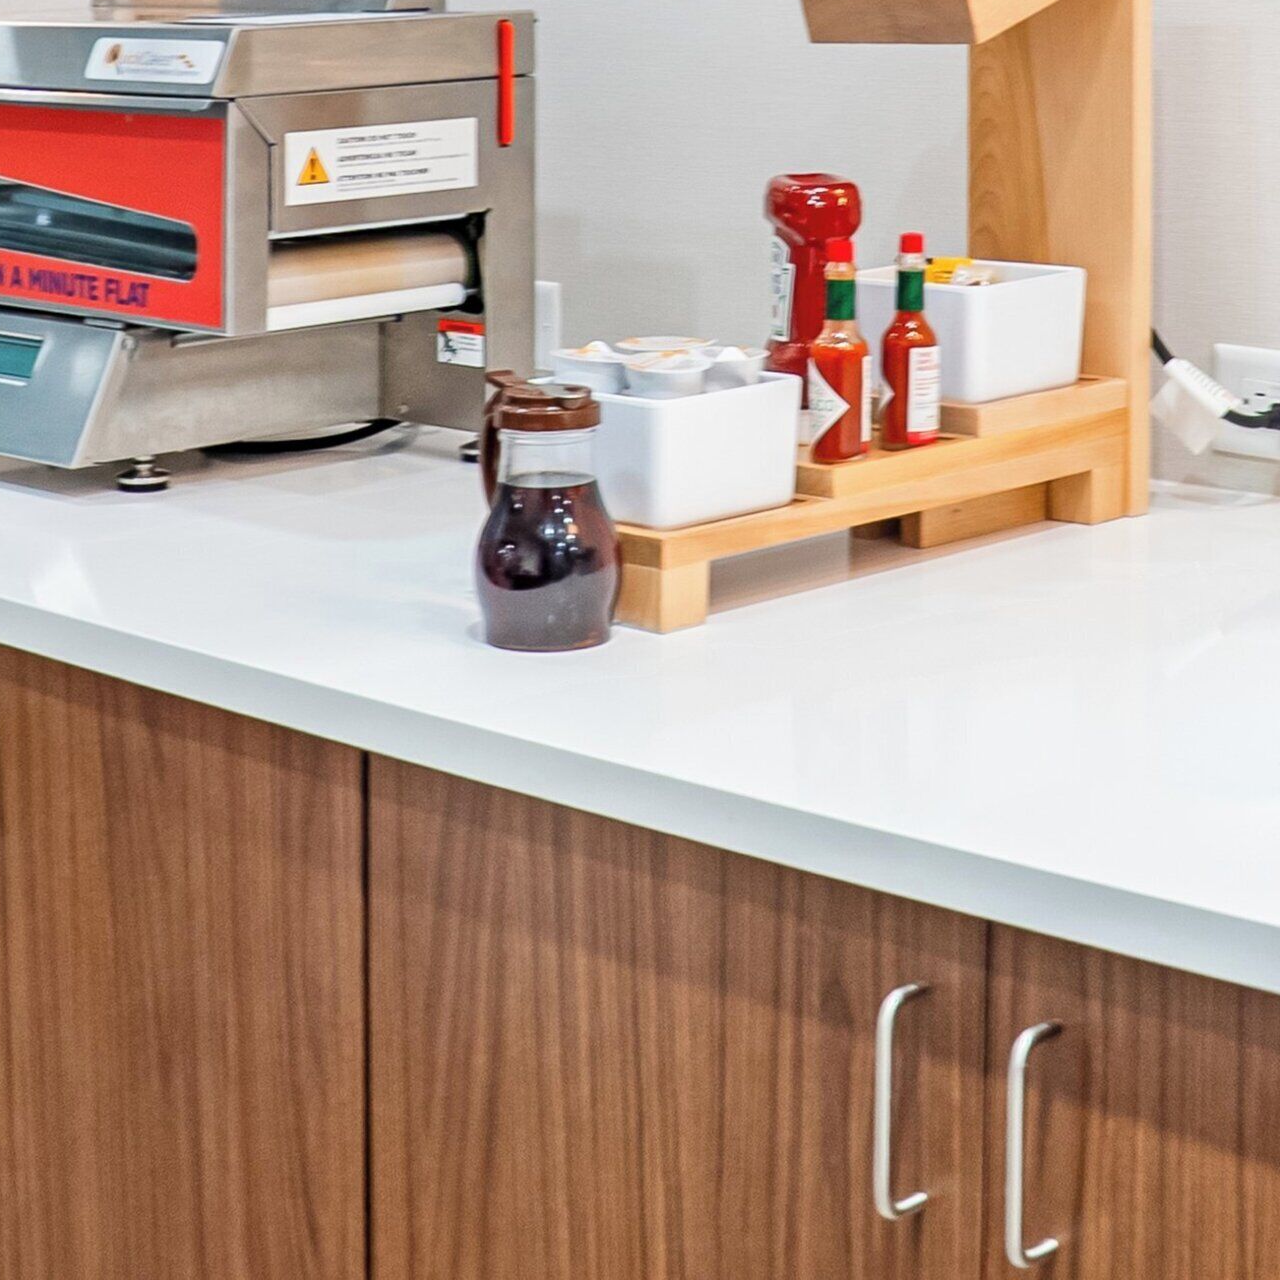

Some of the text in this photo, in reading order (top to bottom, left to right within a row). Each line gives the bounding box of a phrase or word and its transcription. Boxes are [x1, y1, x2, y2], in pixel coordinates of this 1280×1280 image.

[10, 266, 23, 288] A
[28, 268, 100, 301] MINUTE
[104, 277, 150, 307] FLAT
